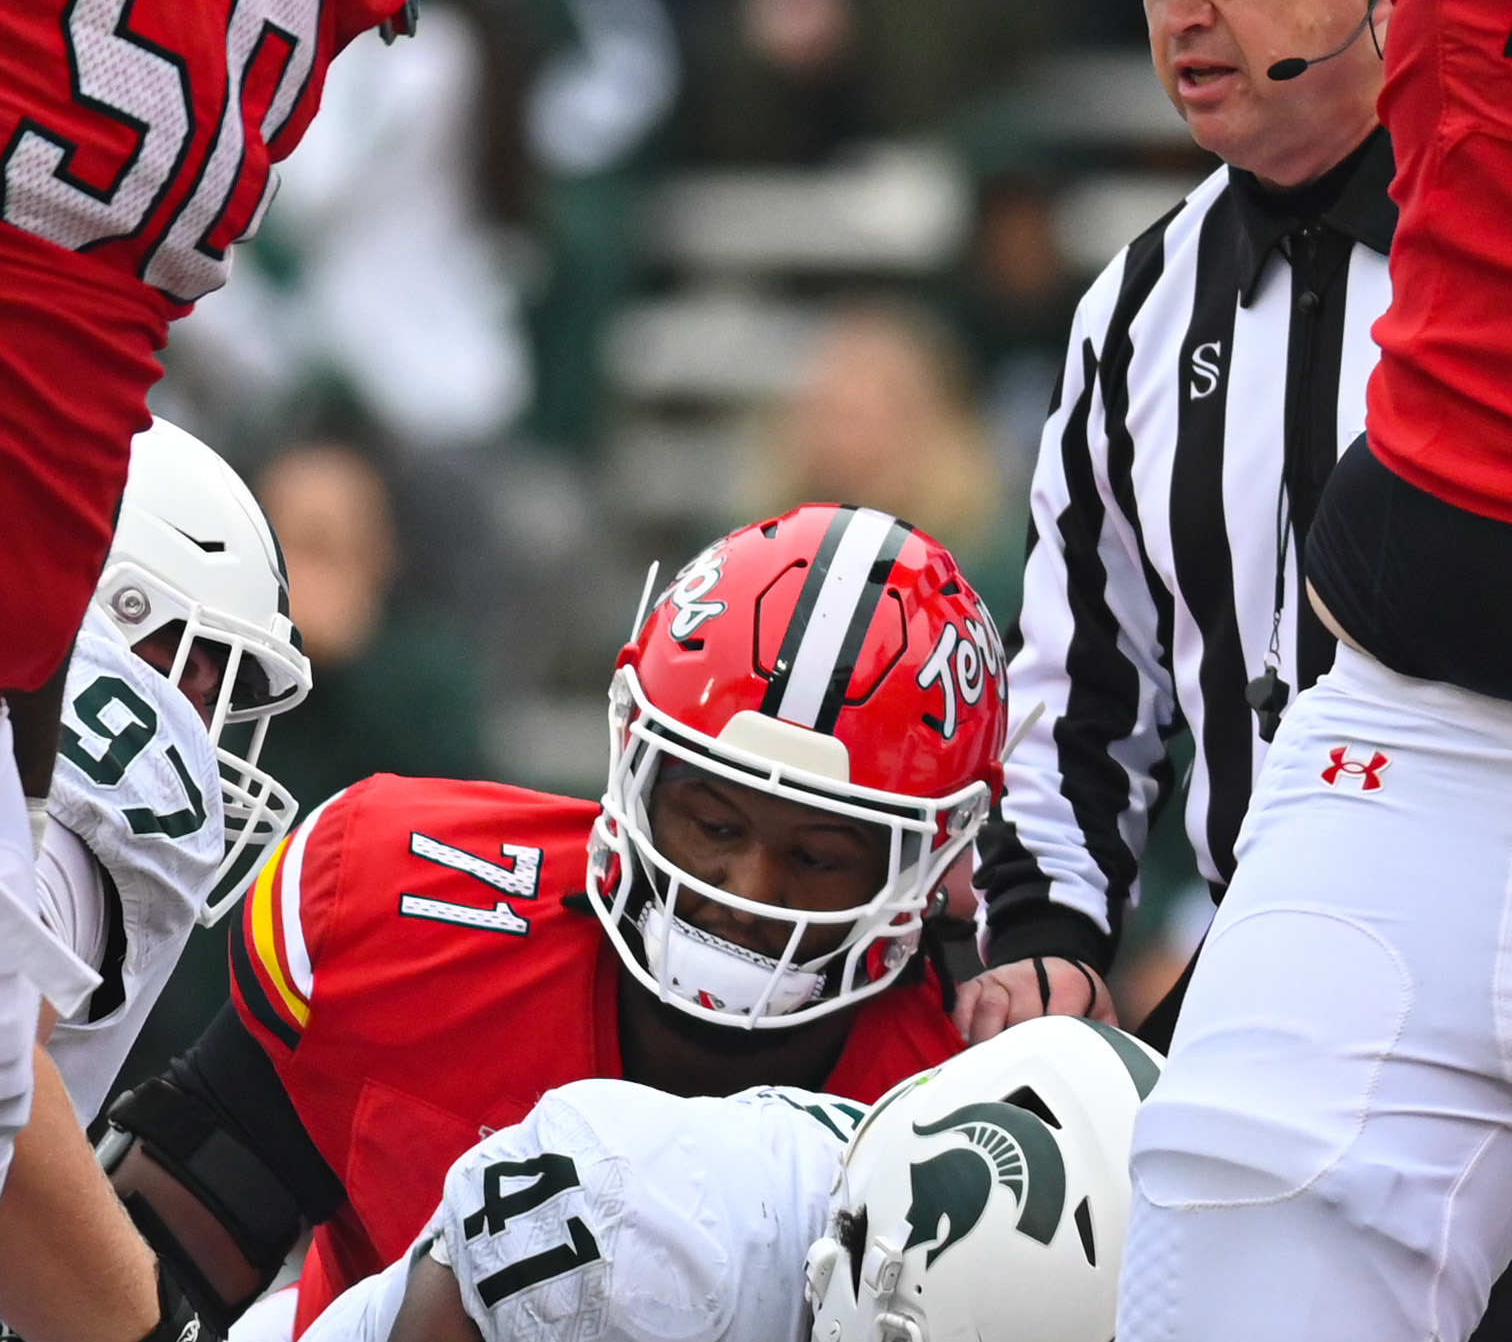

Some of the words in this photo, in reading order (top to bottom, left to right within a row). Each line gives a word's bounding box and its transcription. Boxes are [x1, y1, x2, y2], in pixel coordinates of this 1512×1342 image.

[1190, 340, 1223, 401] S
[59, 675, 208, 839] 97
[399, 830, 545, 939] 71
[463, 1152, 602, 1309] 41
